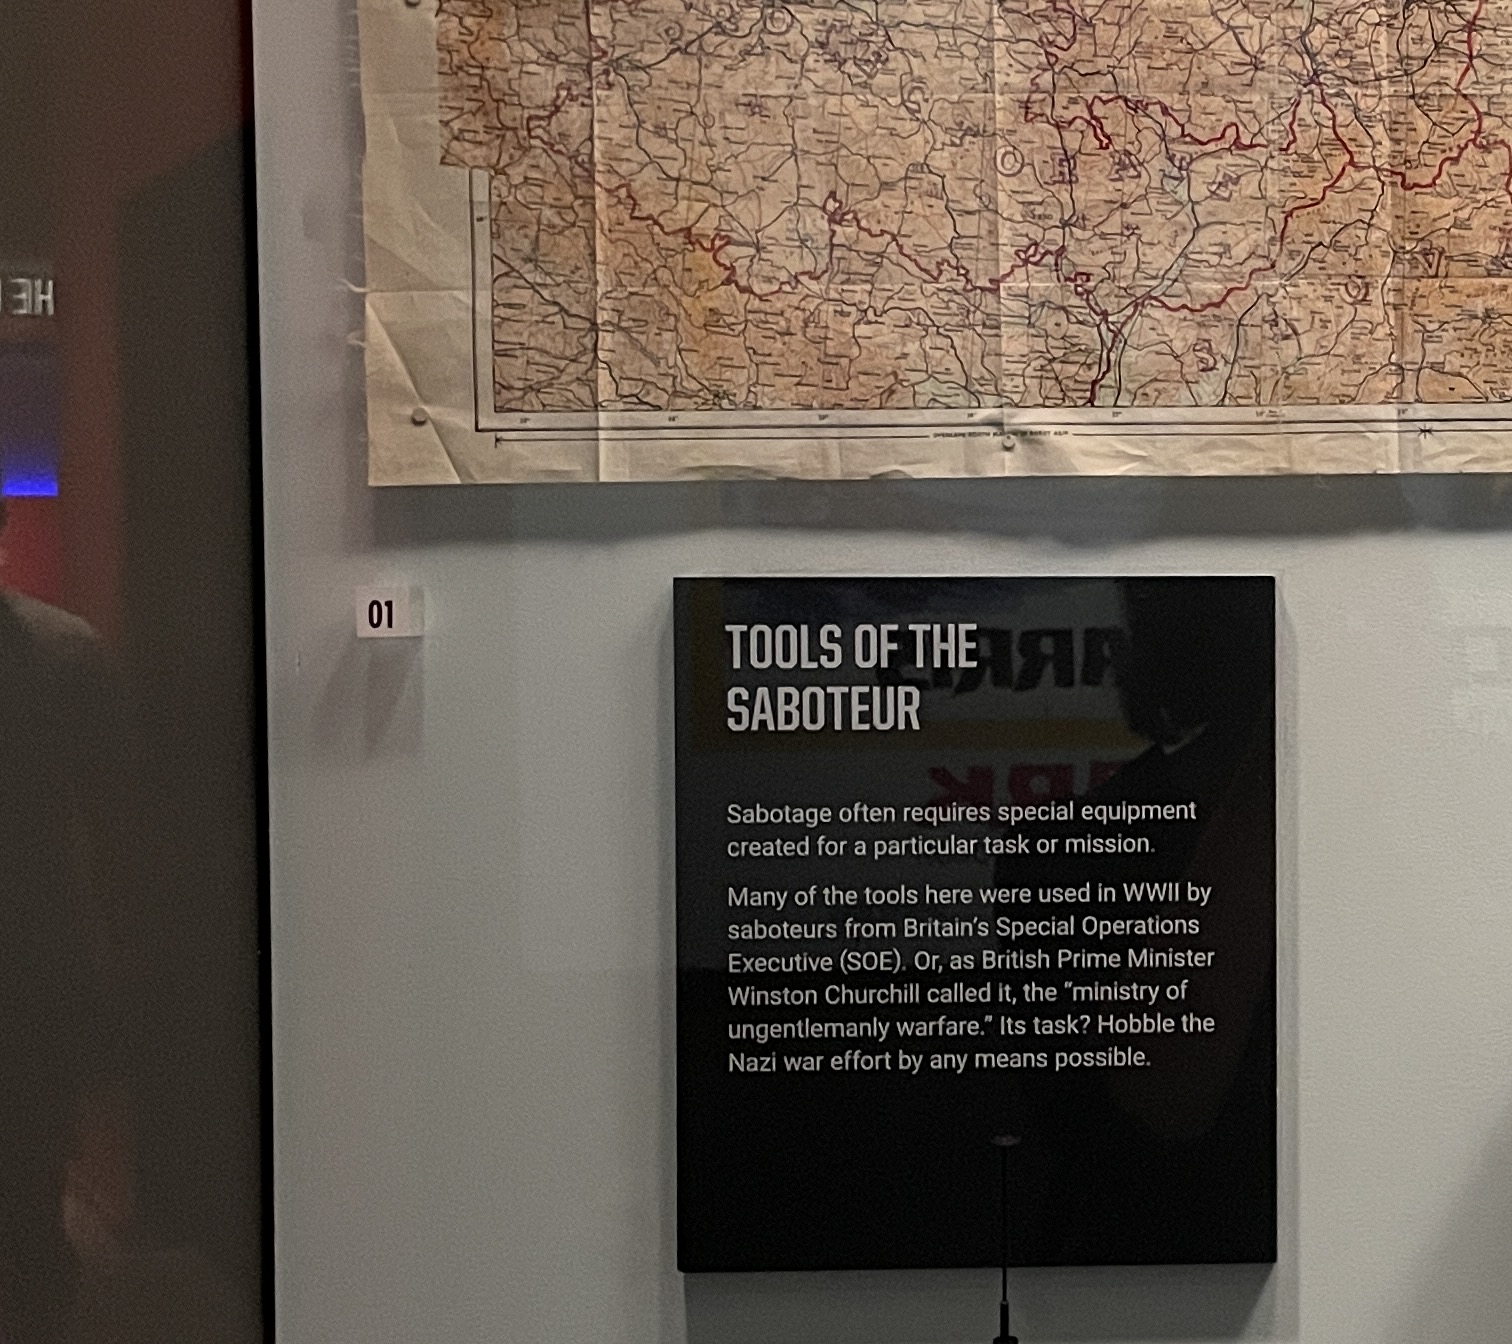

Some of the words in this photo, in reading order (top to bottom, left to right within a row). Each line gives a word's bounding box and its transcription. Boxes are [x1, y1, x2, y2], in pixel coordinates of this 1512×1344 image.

[368, 600, 393, 629] 01
[724, 624, 842, 669] TOOLS
[854, 624, 899, 669] OF
[908, 623, 978, 668] THE
[727, 685, 920, 731] SABOTEUR
[727, 803, 832, 828] Sabotage
[839, 801, 896, 823] often
[903, 801, 991, 827] requires
[998, 800, 1074, 826] special
[1081, 800, 1197, 825] equipment
[727, 835, 810, 857] created
[816, 835, 848, 856] for
[854, 840, 867, 856] a
[874, 834, 978, 860] particular
[983, 833, 1030, 854] task
[1036, 838, 1059, 854] or
[1065, 833, 1155, 854] mission.
[728, 886, 788, 911] Many
[794, 884, 817, 906] of
[822, 884, 858, 906] the
[864, 884, 918, 905] tools
[925, 883, 973, 904] here
[979, 887, 1032, 904] were
[1038, 881, 1090, 903] used
[1098, 882, 1116, 903] in
[1122, 882, 1179, 902] WWII
[1187, 881, 1212, 907] by
[727, 918, 837, 940] saboteurs
[845, 917, 896, 939] from
[996, 914, 1075, 940] Special
[1082, 915, 1200, 940] Operations
[728, 952, 833, 973] Executive
[914, 950, 943, 973] Or,
[949, 954, 975, 970] as
[982, 948, 1050, 970] British
[1058, 948, 1121, 969] Prime
[1128, 947, 1216, 968] Minister
[727, 985, 818, 1006] Winston
[825, 983, 920, 1005] Churchill
[927, 981, 991, 1003] called
[1022, 981, 1058, 1002] the
[1166, 979, 1189, 1000] of
[728, 1016, 890, 1044] ungentlemanly
[1000, 1015, 1026, 1036] Its
[1032, 1014, 1091, 1035] task?
[1098, 1012, 1175, 1034] Hobble
[1180, 1012, 1215, 1033] the
[729, 1052, 776, 1072] Nazi
[783, 1055, 824, 1071] war
[830, 1049, 892, 1071] effort
[898, 1049, 923, 1075] by
[930, 1053, 968, 1074] any
[975, 1052, 1048, 1068] means
[1055, 1045, 1151, 1072] possible.
